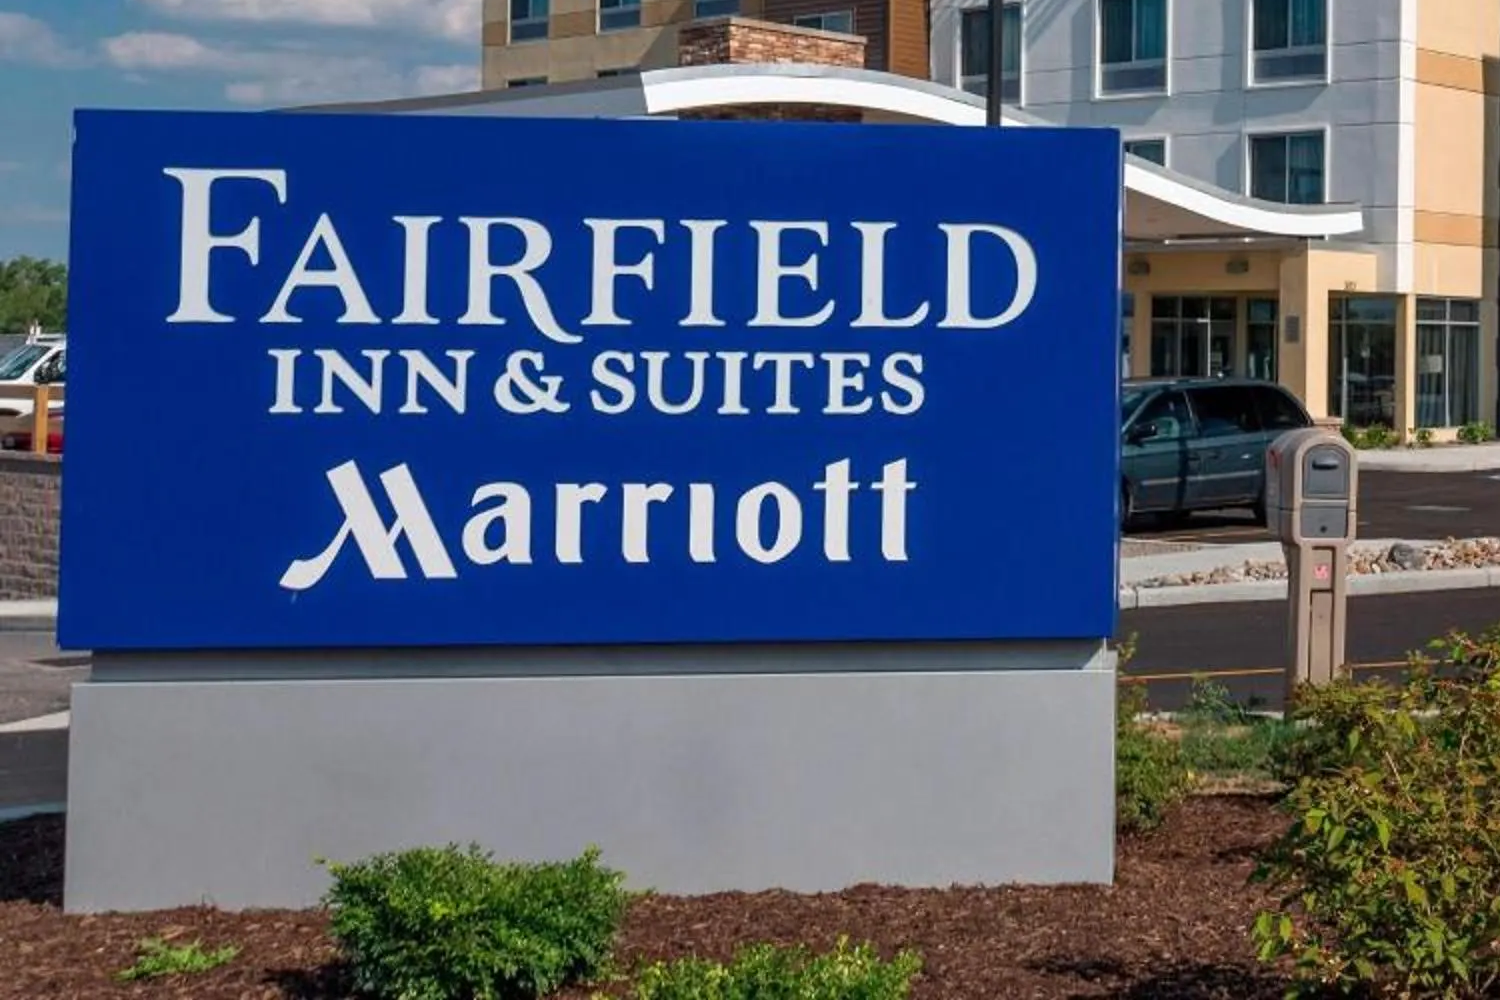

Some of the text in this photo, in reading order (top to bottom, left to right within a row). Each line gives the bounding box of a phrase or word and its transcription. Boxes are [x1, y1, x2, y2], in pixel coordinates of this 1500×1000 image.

[163, 166, 1038, 345] FAIRFIELD
[267, 348, 926, 416] INN & SUITES
[279, 456, 918, 591] Marriott
